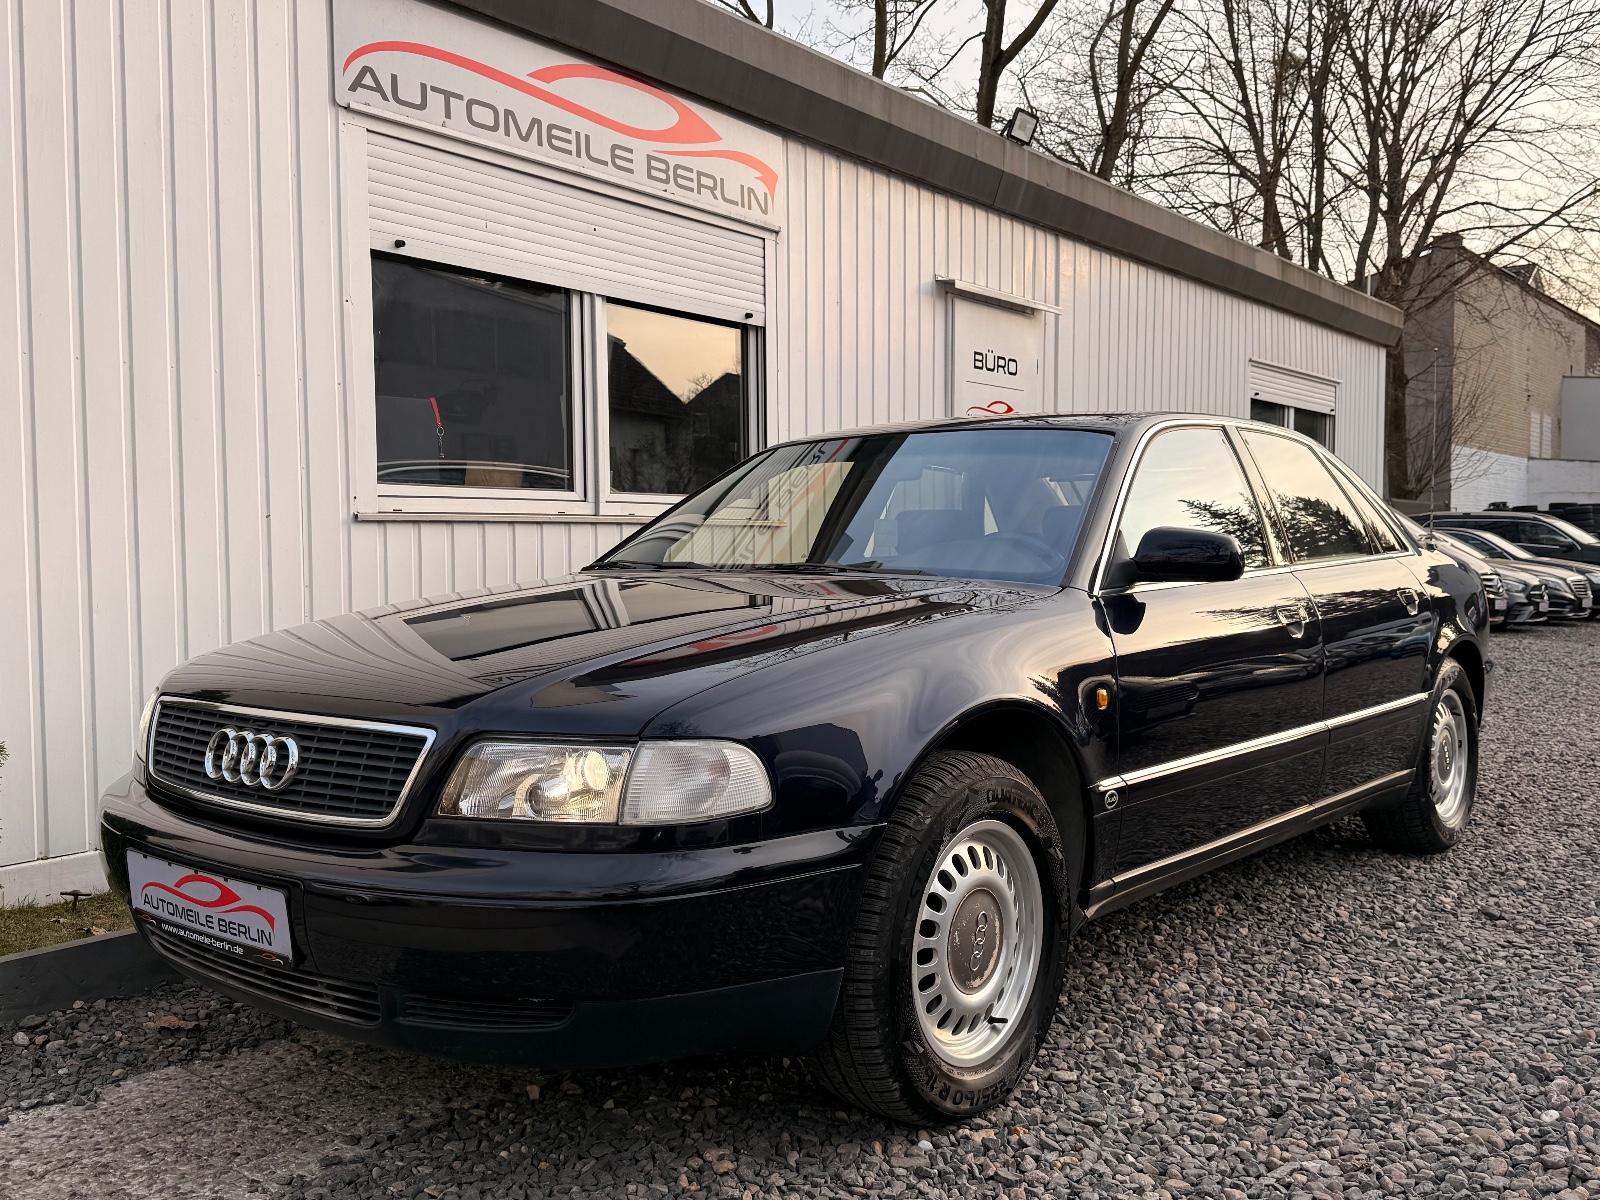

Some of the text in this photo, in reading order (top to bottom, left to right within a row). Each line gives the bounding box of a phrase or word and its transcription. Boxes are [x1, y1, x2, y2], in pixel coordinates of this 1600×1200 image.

[347, 65, 769, 216] AUTOMEILE BERLIN
[973, 349, 1018, 376] BÜRO
[143, 893, 273, 947] AUTOMEILE BERLIN
[161, 922, 244, 955] www.automeile-berlin.de
